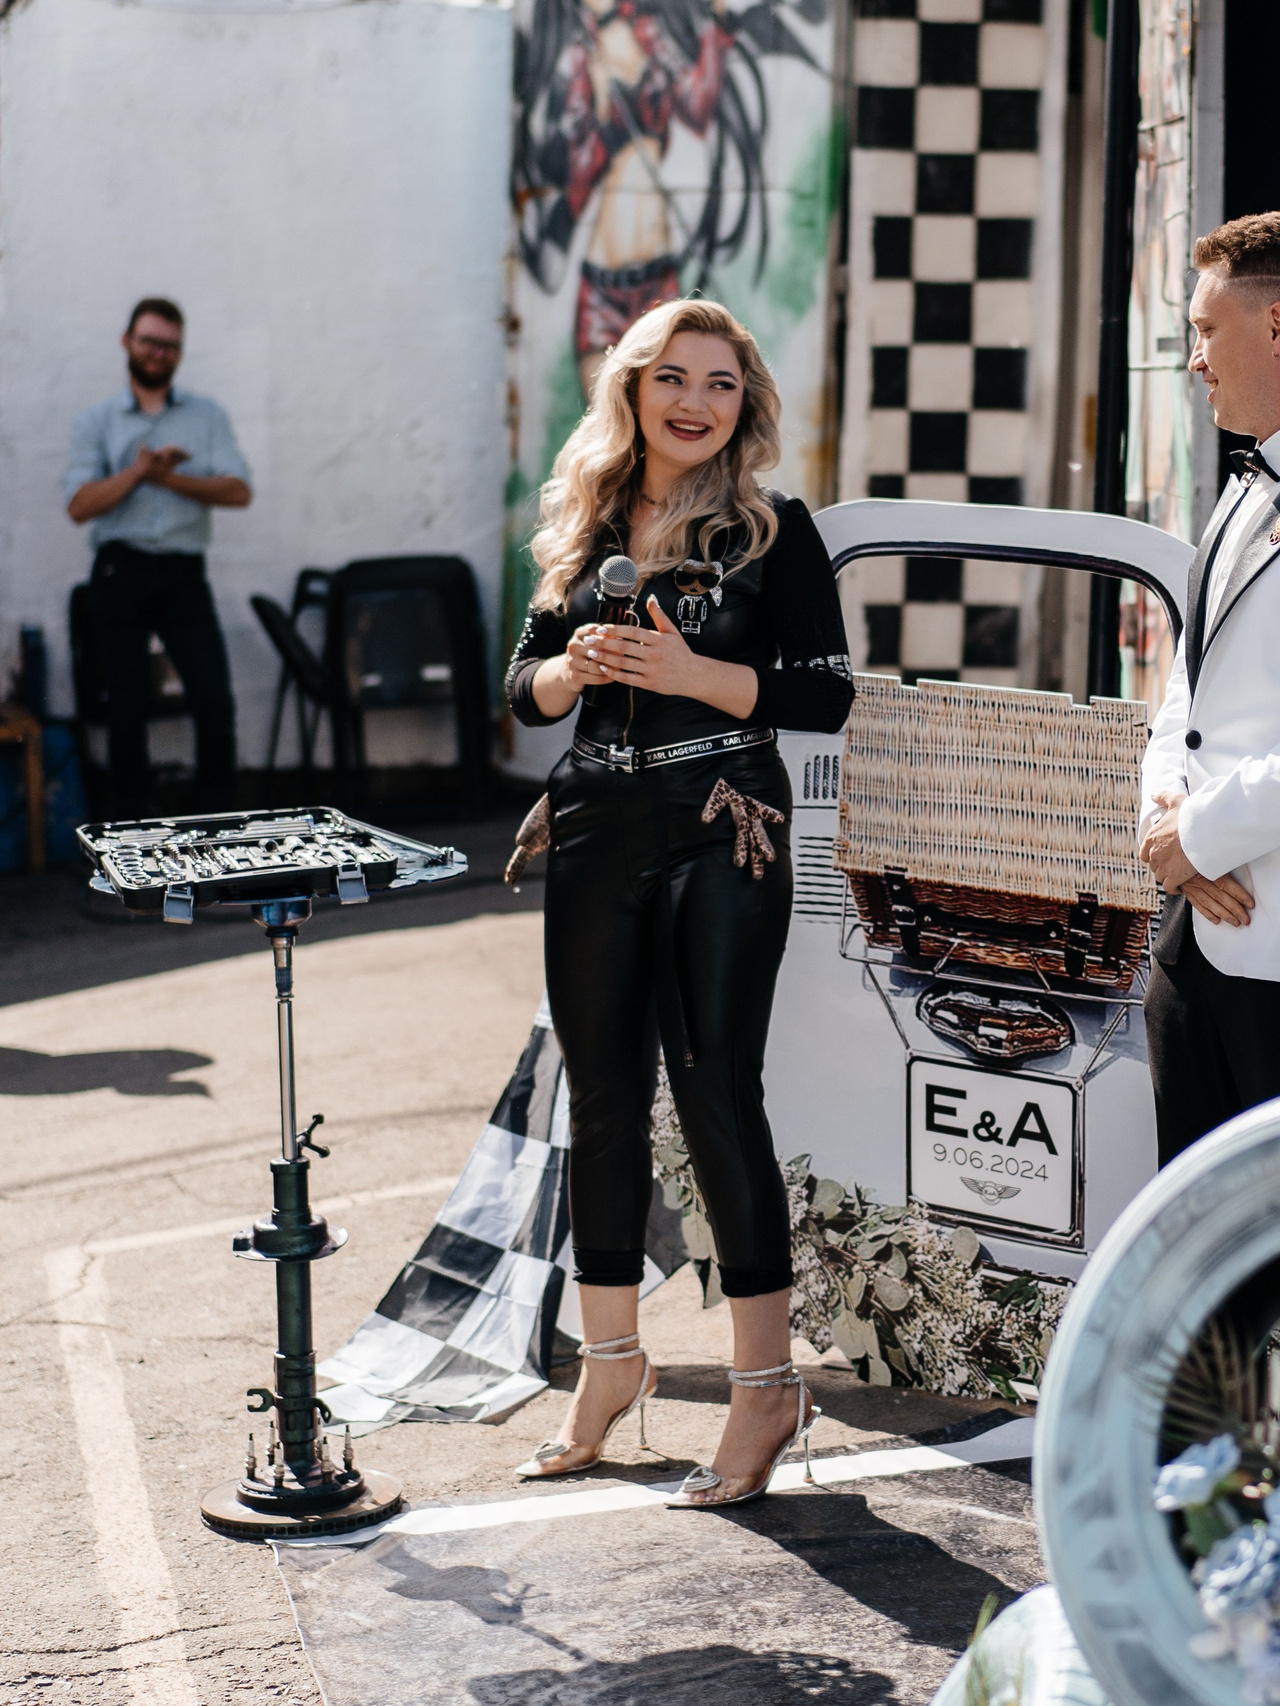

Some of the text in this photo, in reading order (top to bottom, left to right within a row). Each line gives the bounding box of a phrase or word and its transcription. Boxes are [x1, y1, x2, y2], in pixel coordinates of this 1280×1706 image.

[646, 742, 713, 763] KARL LAGERFELD
[722, 736, 741, 747] KARL
[925, 1083, 1059, 1156] E&A
[933, 1143, 1049, 1182] 9.06.2024
